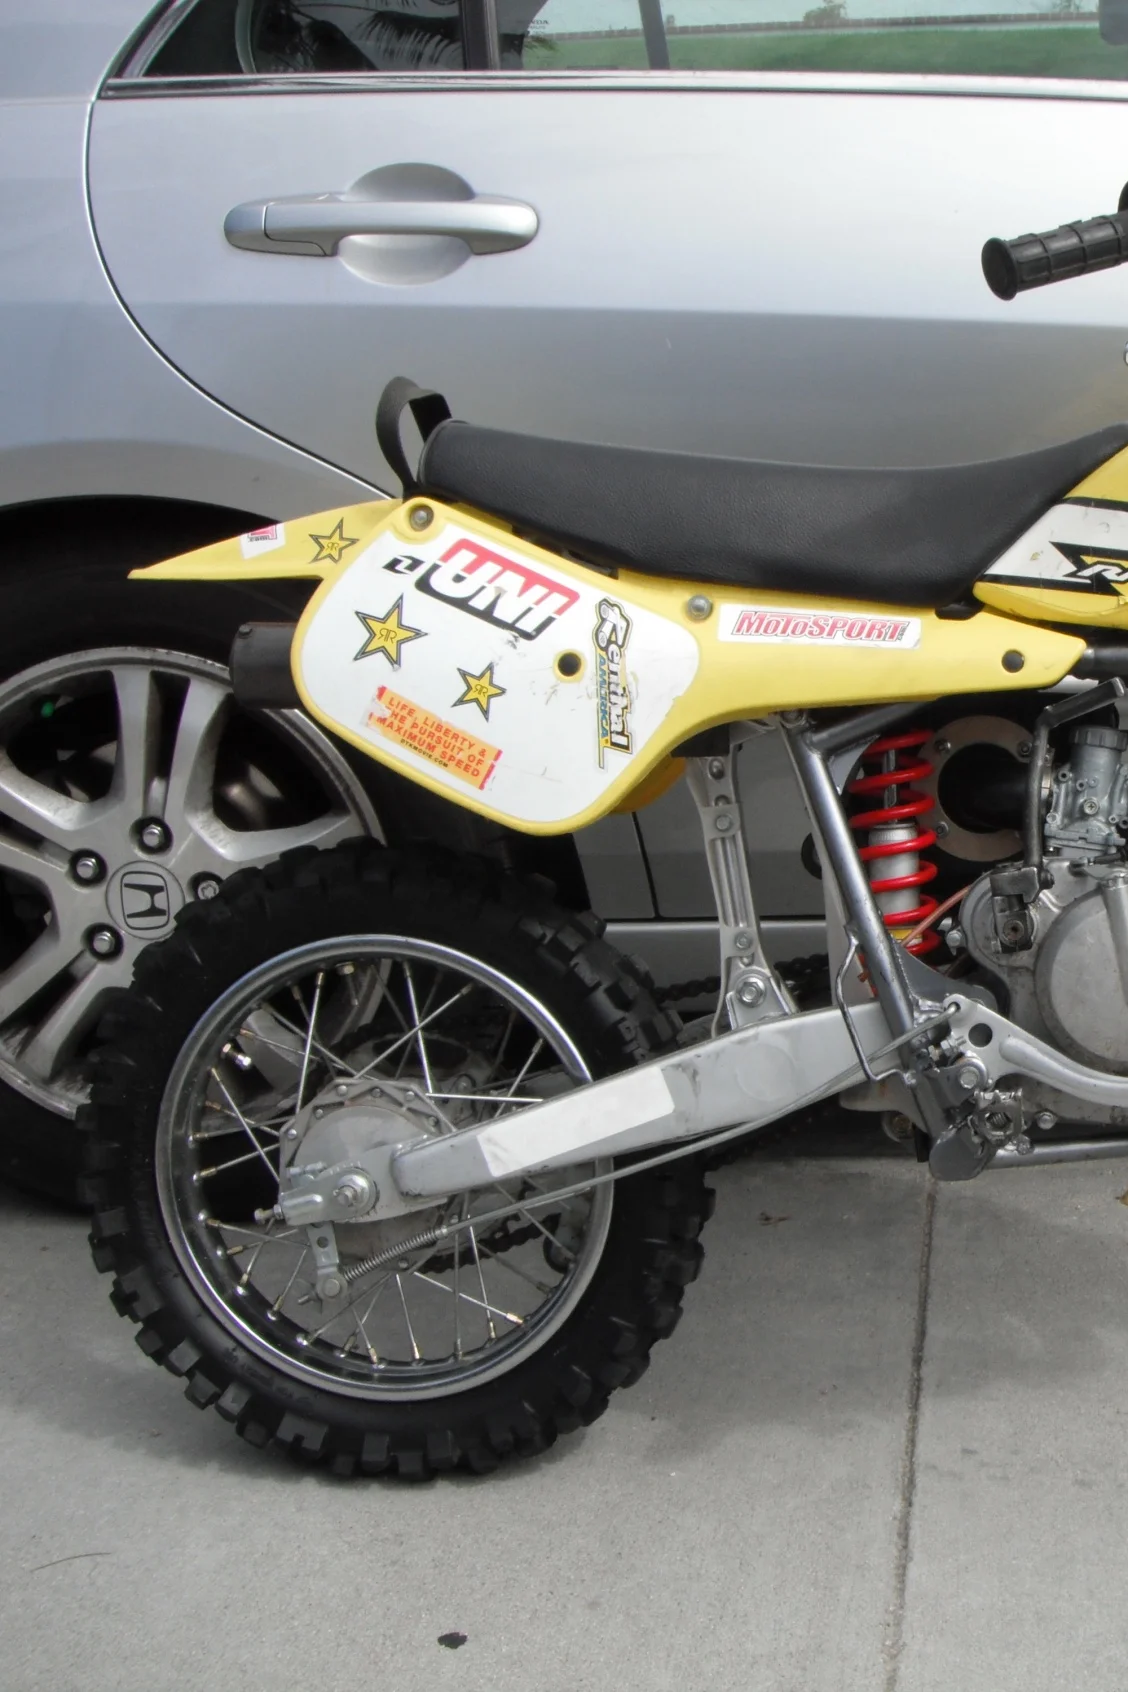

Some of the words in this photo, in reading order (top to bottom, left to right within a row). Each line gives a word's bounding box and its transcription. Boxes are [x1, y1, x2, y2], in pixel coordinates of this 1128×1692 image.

[423, 543, 575, 638] UNI
[376, 717, 437, 753] MAXIMUM
[440, 750, 481, 778] SPEED
[385, 704, 408, 724] HE
[411, 722, 464, 756] PURSUIT
[467, 754, 485, 767] OF
[423, 716, 475, 750] LIBERTY
[479, 748, 487, 758] &
